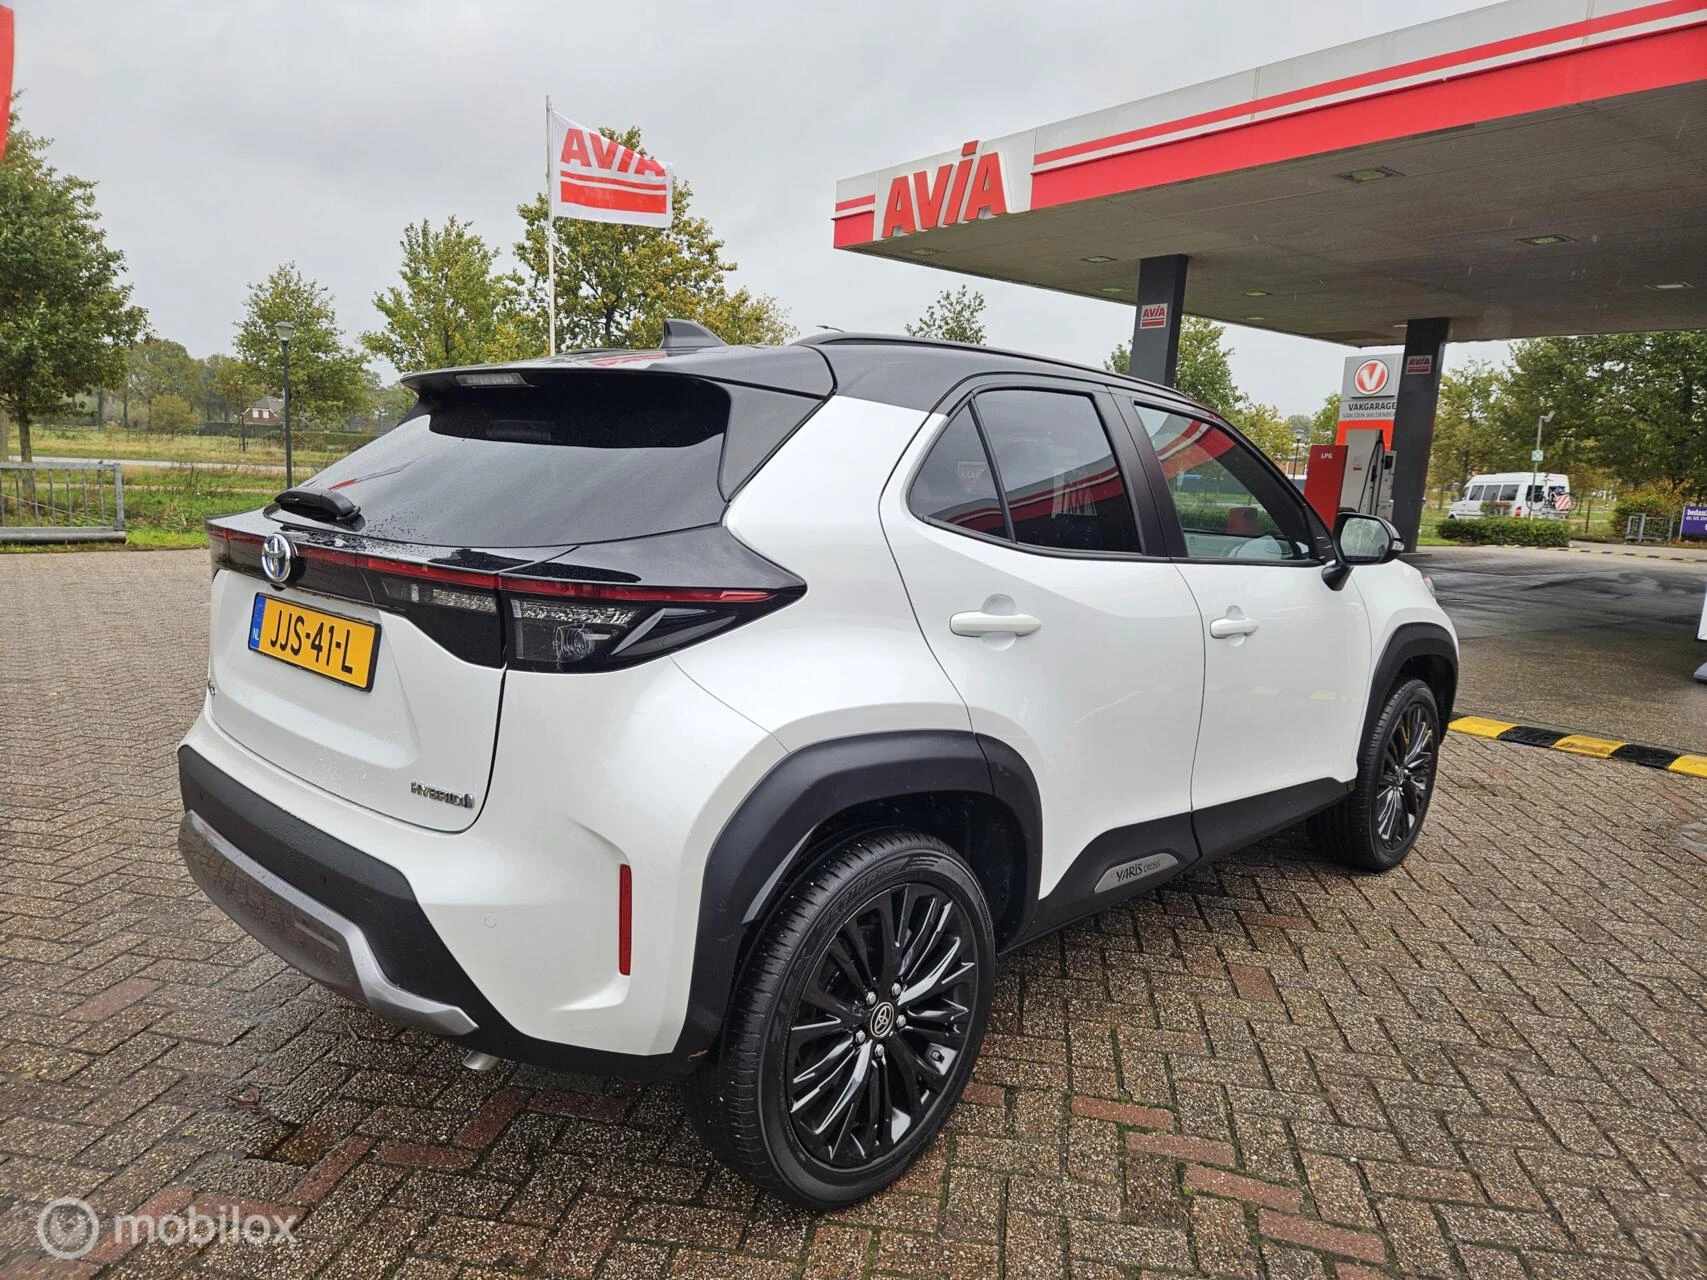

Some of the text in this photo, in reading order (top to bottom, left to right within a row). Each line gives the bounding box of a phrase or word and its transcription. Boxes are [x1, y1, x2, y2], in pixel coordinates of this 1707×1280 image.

[560, 128, 667, 177] AVIA
[1348, 402, 1397, 411] VAKGARAGE
[270, 609, 353, 675] JJS-41-L
[410, 782, 464, 807] HYBRID
